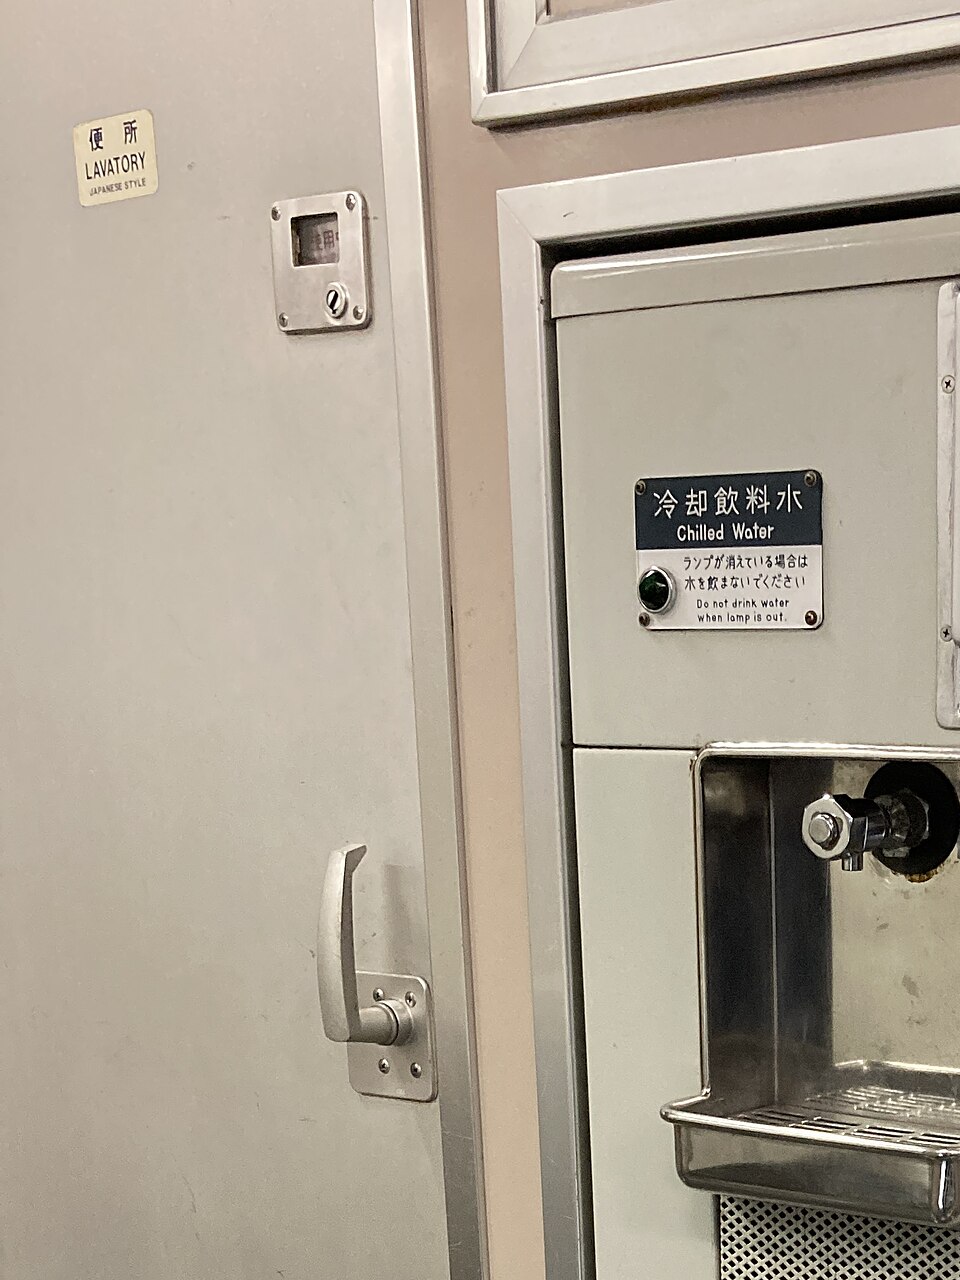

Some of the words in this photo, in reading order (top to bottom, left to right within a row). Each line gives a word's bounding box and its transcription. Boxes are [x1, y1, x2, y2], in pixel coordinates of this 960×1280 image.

[89, 119, 138, 151] 便所
[85, 151, 146, 180] LAVATORY
[90, 182, 123, 196] JAPANESE
[124, 178, 147, 190] STYLE
[653, 483, 803, 519] 冷却飲料水
[676, 523, 724, 542] Chilled
[732, 521, 775, 541] Water
[683, 554, 809, 571] ランプが消えている場合は
[684, 573, 806, 591] 水を飲まないでください
[696, 599, 709, 609] Do
[713, 599, 729, 609] not
[732, 598, 758, 609] drink
[761, 597, 790, 608] water
[697, 613, 723, 623] when
[727, 612, 751, 624] lamp
[753, 611, 762, 622] is
[766, 612, 787, 622] out.
